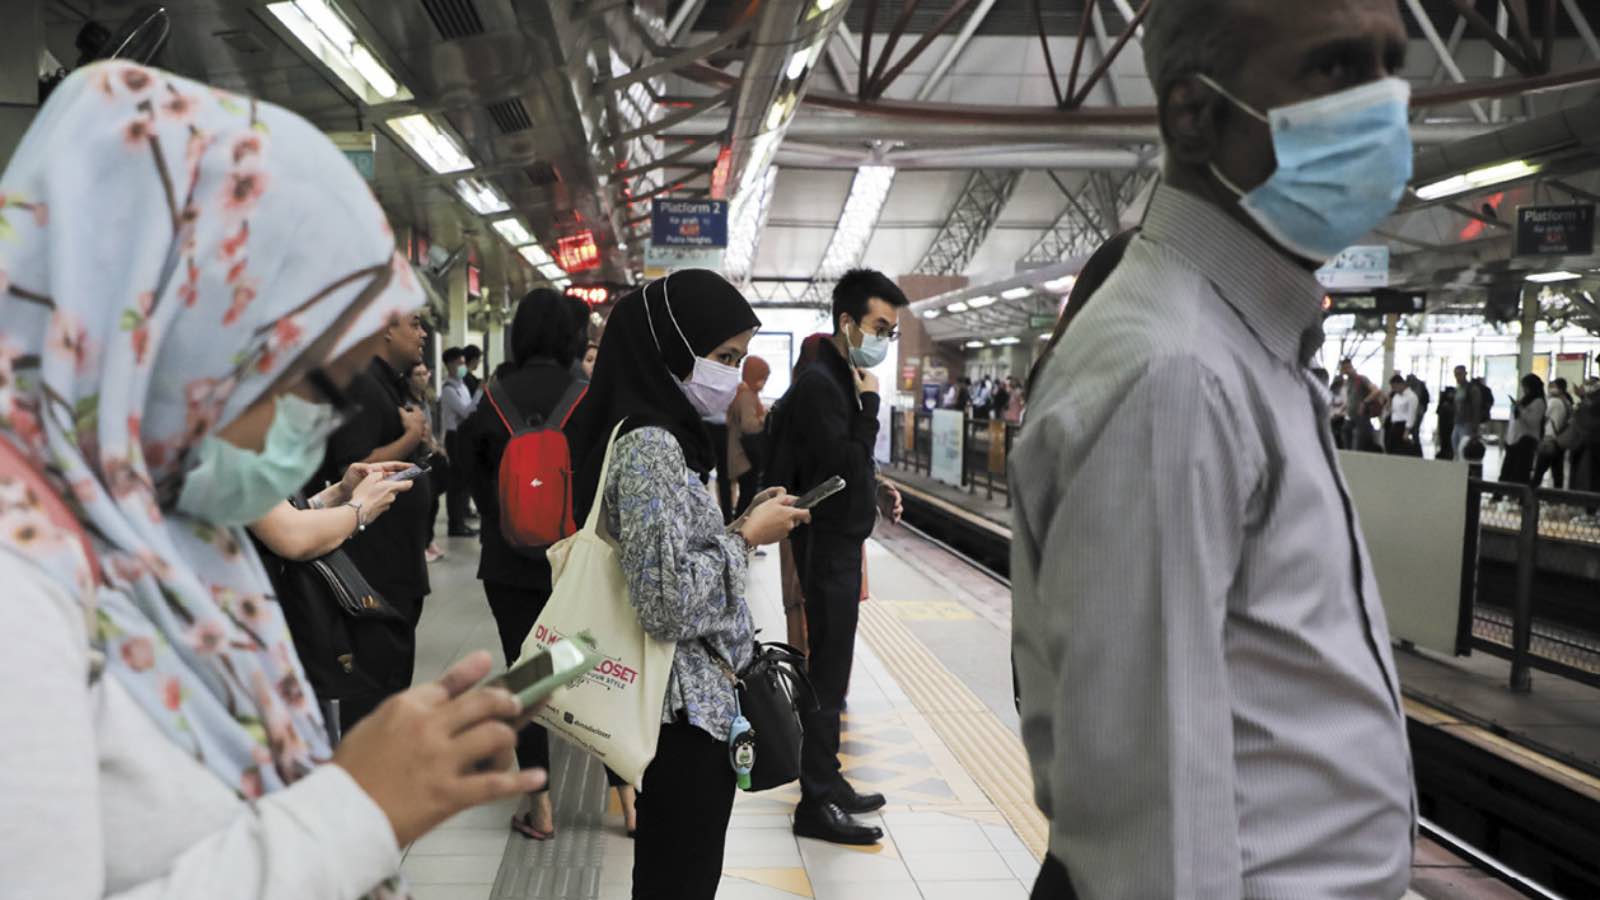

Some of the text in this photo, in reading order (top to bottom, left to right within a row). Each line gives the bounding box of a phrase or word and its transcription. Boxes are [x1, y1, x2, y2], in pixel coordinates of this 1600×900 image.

[660, 202, 720, 214] Platform 2
[1524, 210, 1587, 223] Platform 1
[535, 624, 549, 642] DI
[606, 677, 627, 690] STYLE
